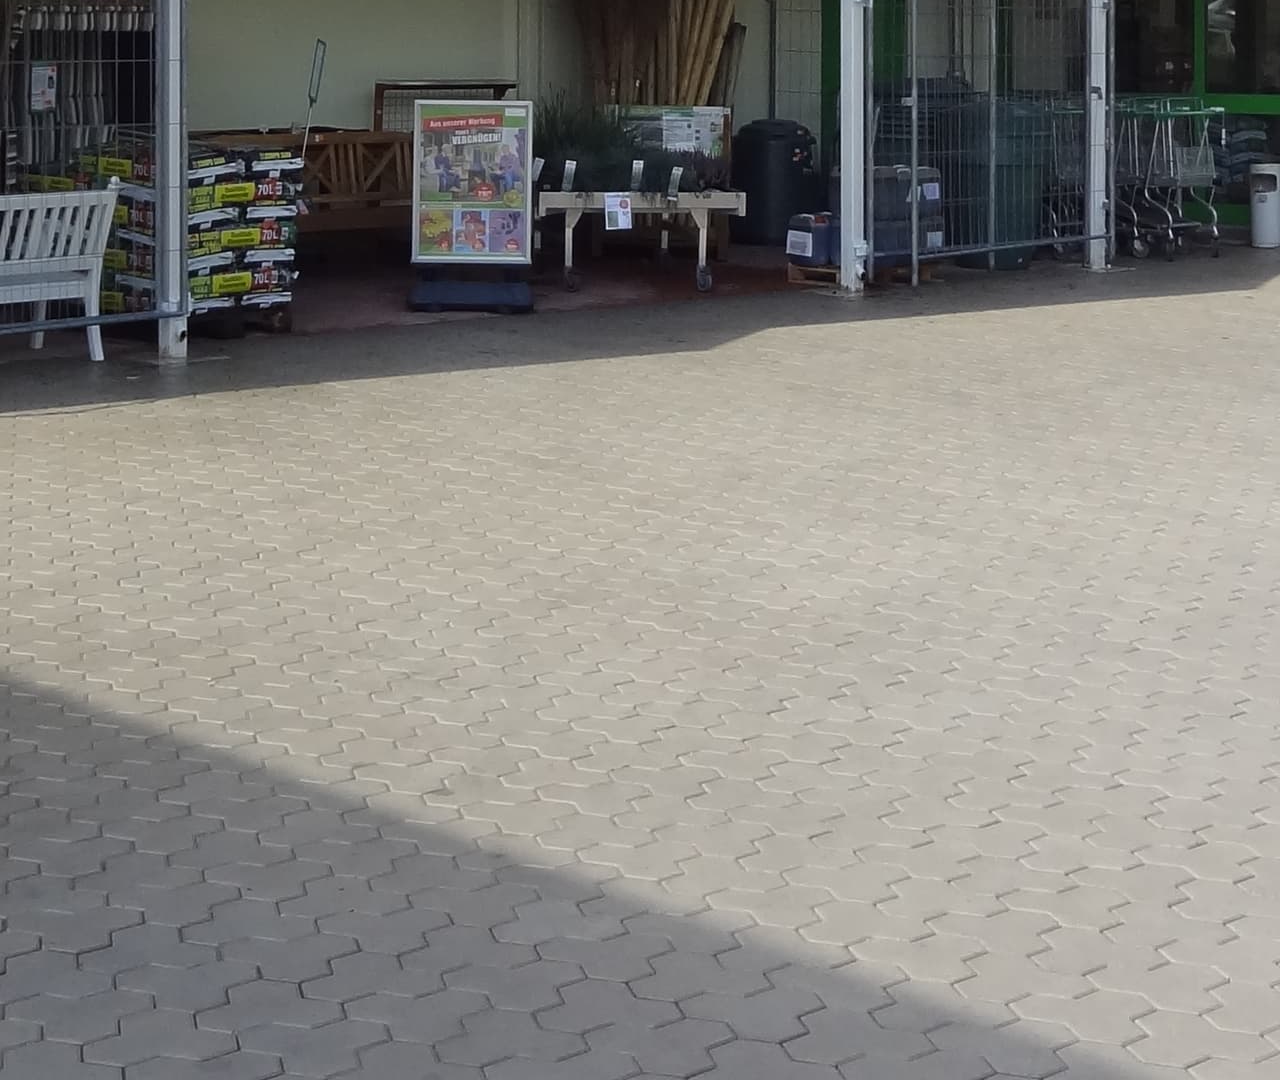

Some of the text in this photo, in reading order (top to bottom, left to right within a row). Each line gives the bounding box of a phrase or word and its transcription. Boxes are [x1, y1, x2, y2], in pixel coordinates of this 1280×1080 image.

[429, 120, 442, 128] Aus
[442, 119, 467, 127] unserer
[452, 132, 502, 145] VERGNÜGEN!
